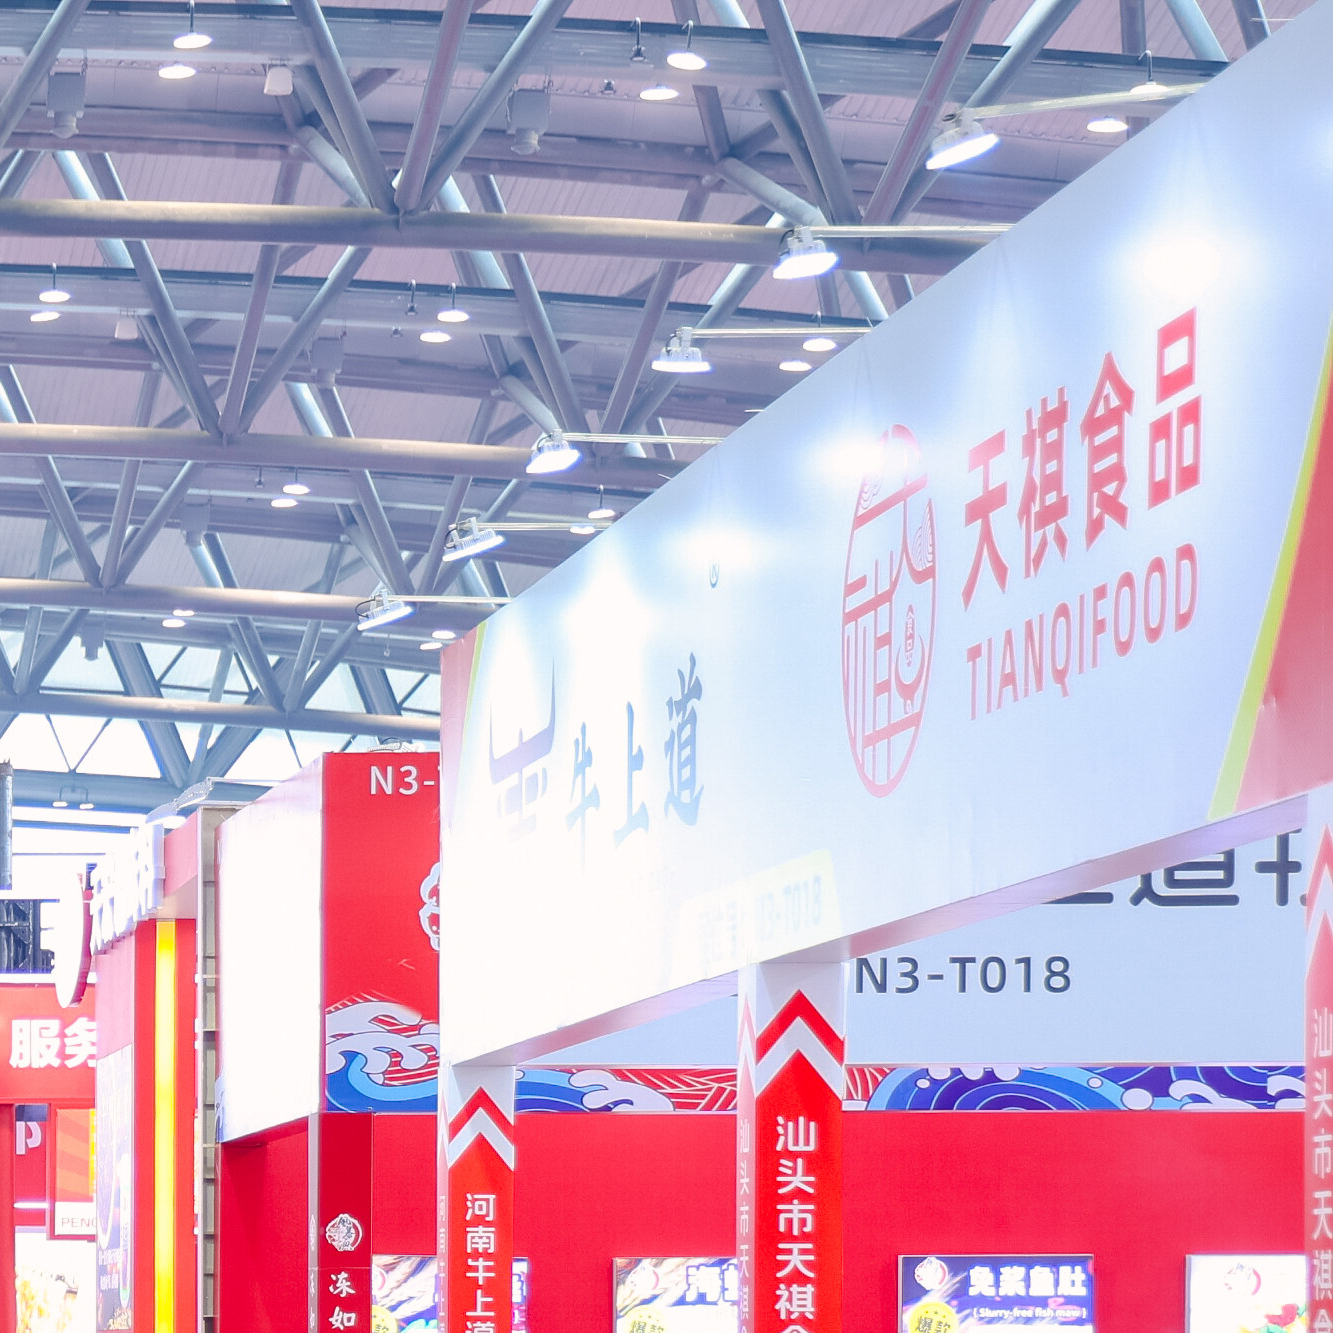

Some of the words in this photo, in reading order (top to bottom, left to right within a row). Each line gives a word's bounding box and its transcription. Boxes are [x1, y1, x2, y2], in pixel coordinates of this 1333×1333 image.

[961, 306, 1202, 612] 天祺食品
[369, 765, 439, 796] N3-
[565, 652, 704, 877] 牛上道
[853, 955, 1072, 994] N3-T018
